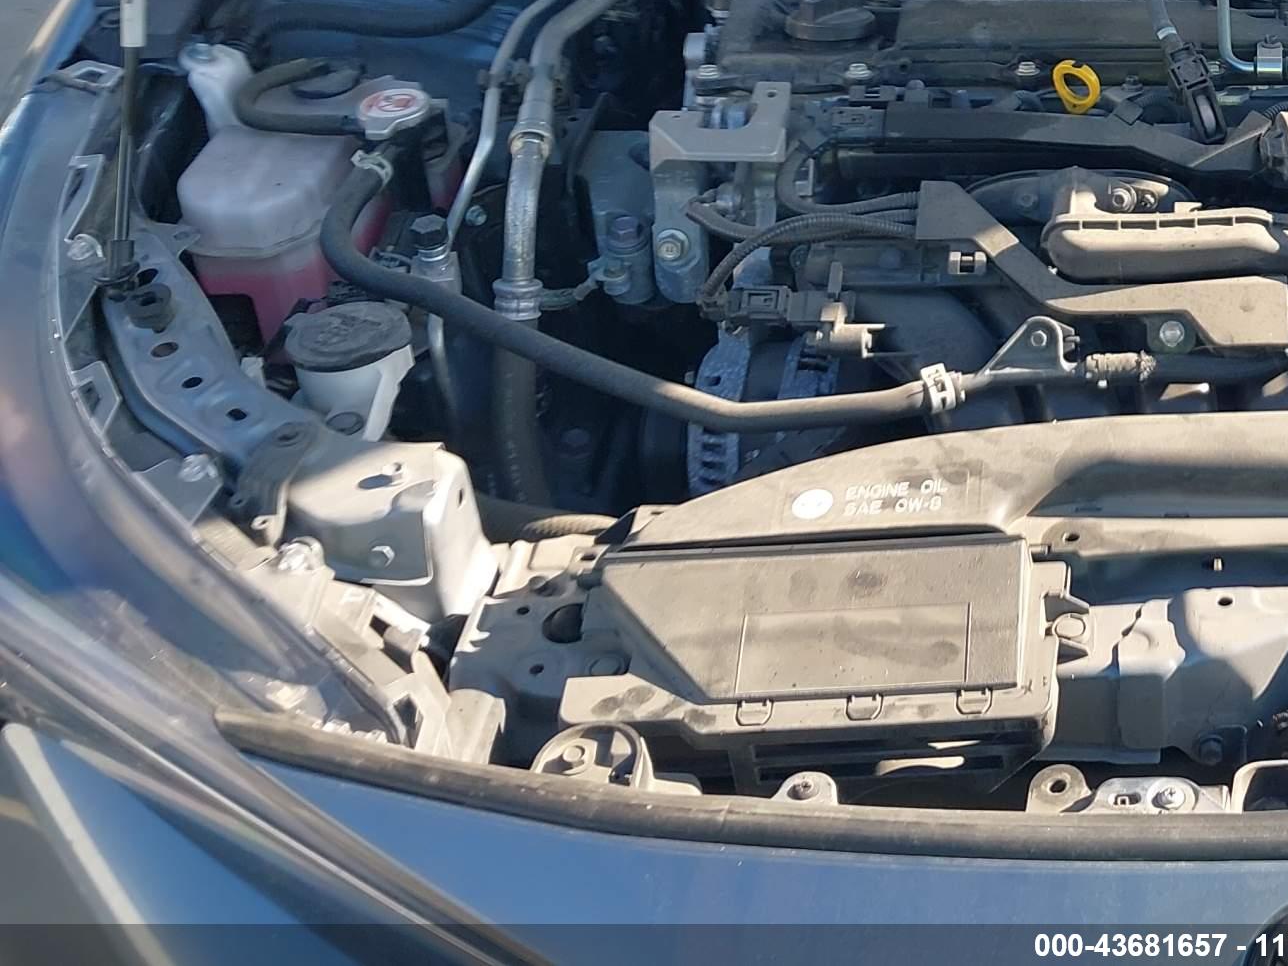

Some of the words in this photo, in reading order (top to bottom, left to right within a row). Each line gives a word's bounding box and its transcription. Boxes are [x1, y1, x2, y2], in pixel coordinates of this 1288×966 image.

[846, 481, 909, 499] ENGINE
[920, 478, 948, 495] OIL
[844, 500, 883, 515] SAE
